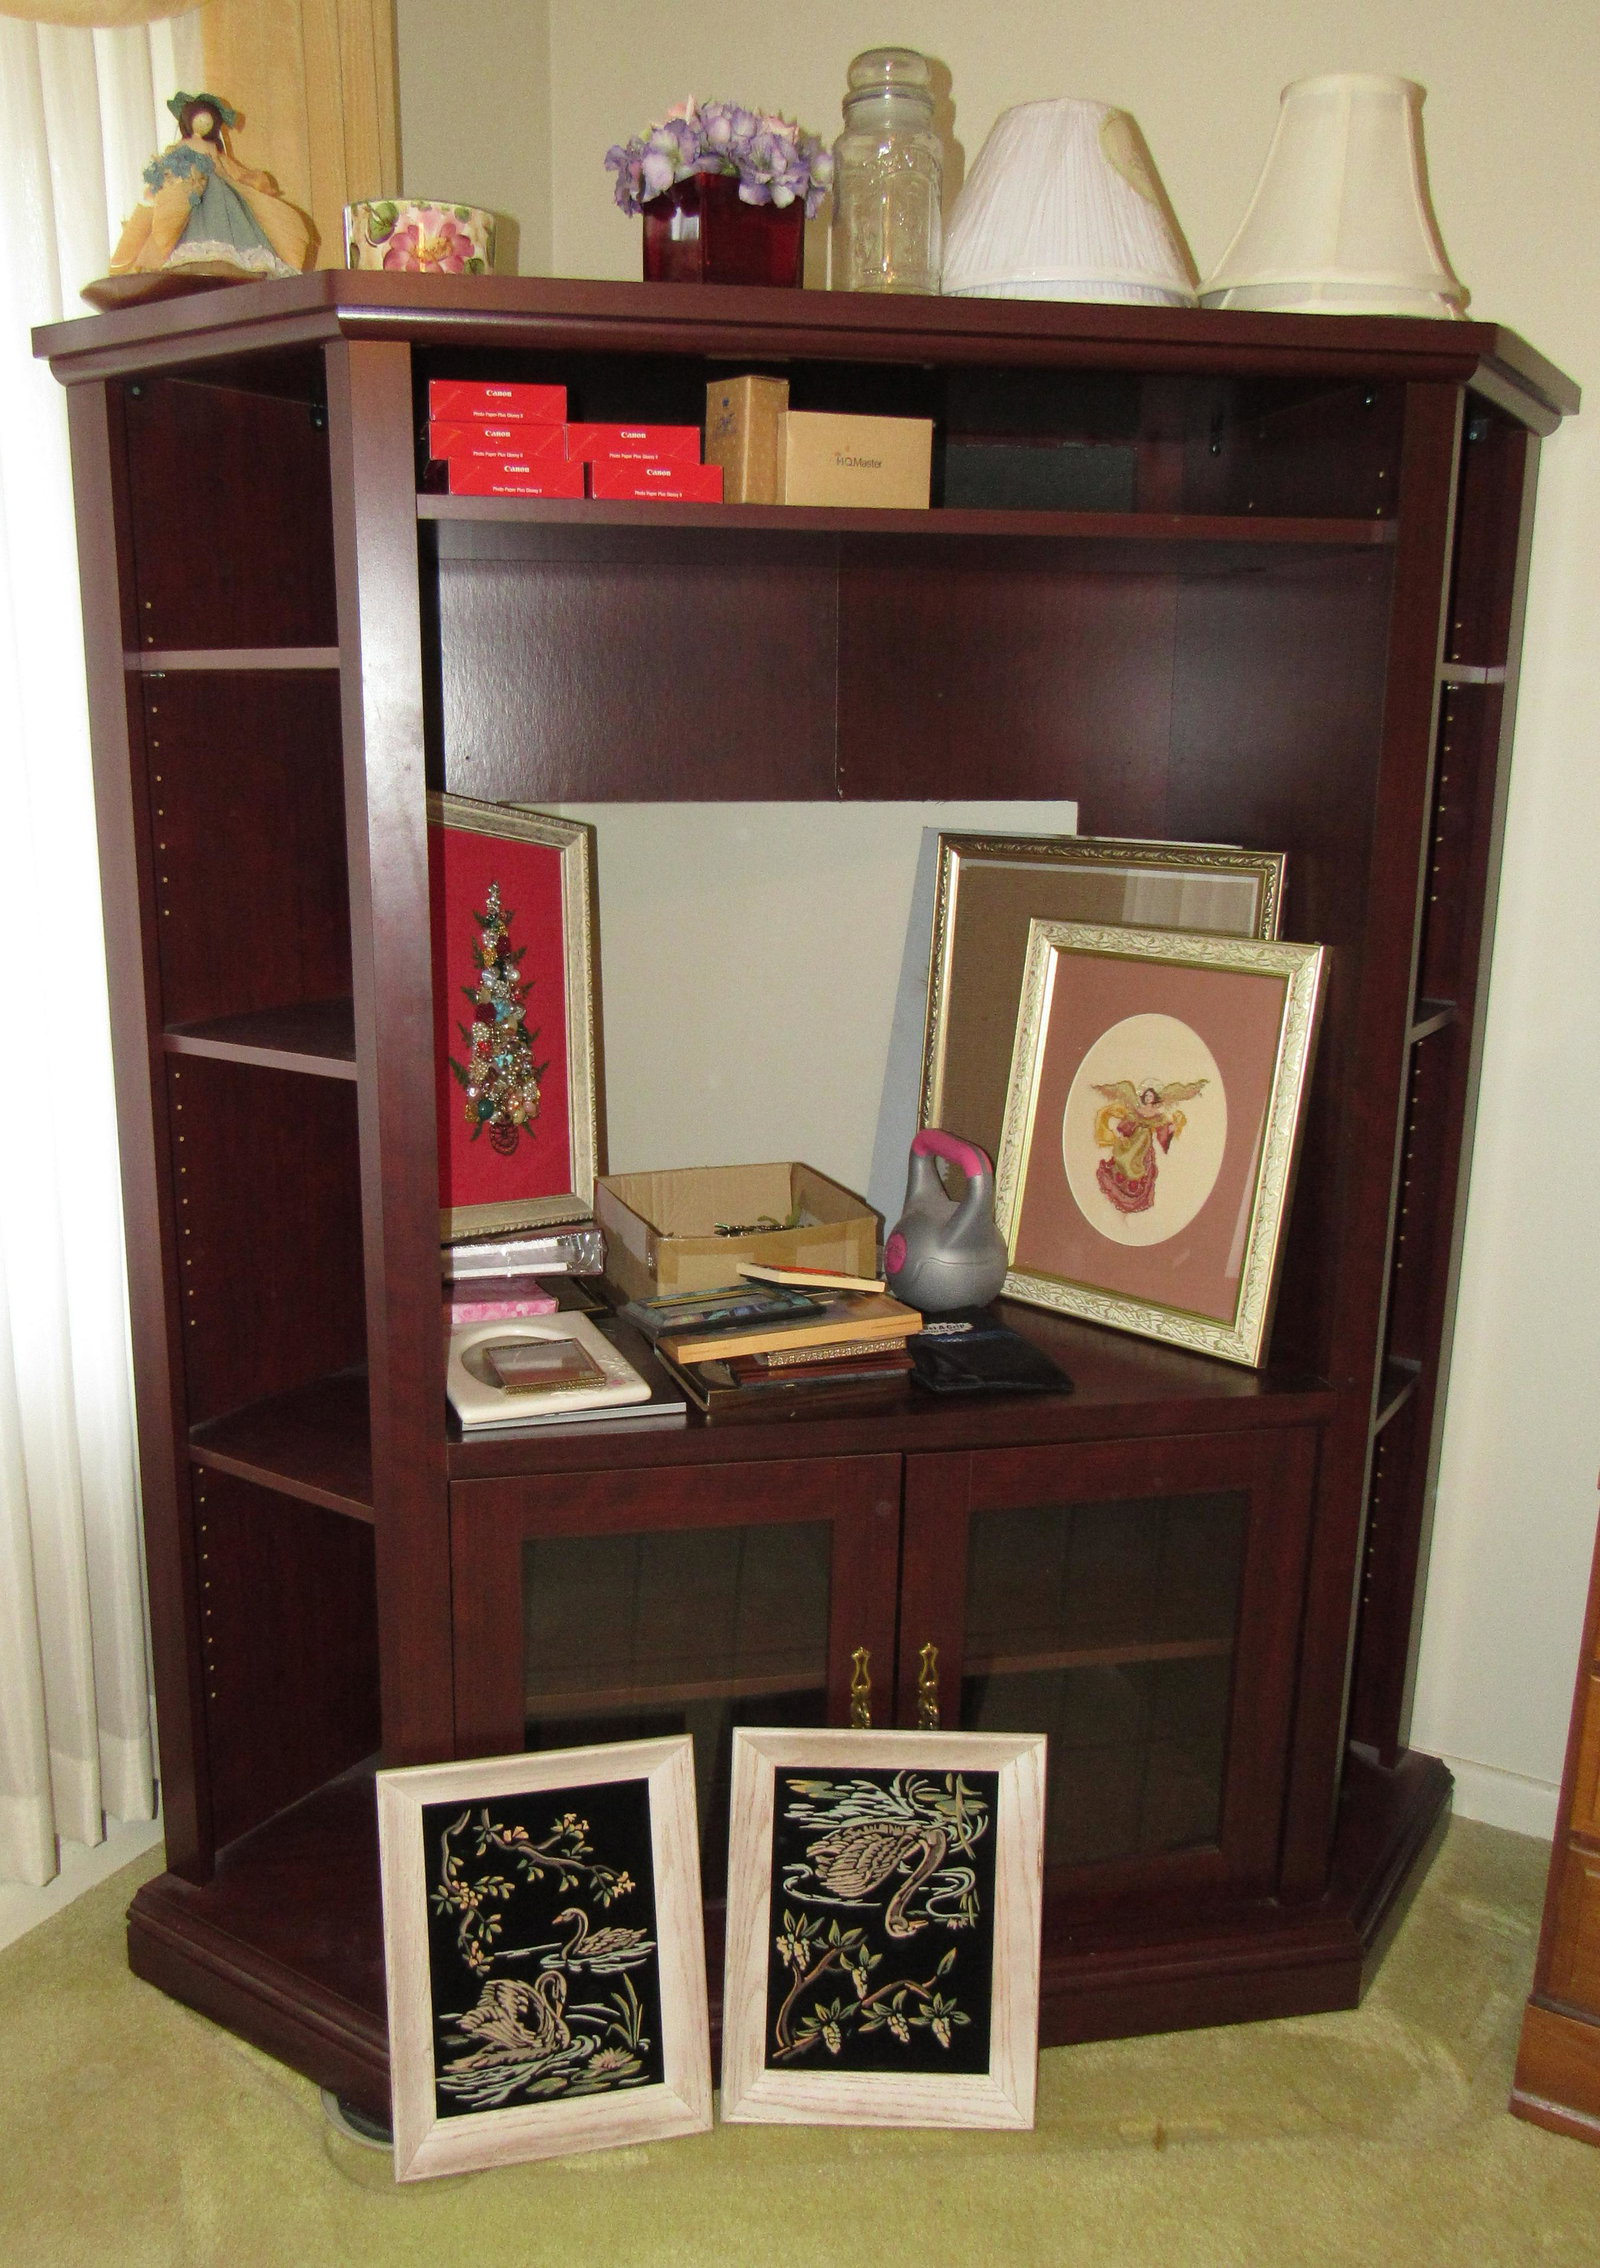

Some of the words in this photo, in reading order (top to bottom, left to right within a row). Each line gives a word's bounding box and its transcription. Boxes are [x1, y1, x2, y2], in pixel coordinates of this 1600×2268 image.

[486, 389, 512, 398] Canon
[485, 430, 511, 438] Canon
[621, 431, 646, 439] Canon
[504, 465, 530, 473] Canon
[646, 469, 671, 477] Canon
